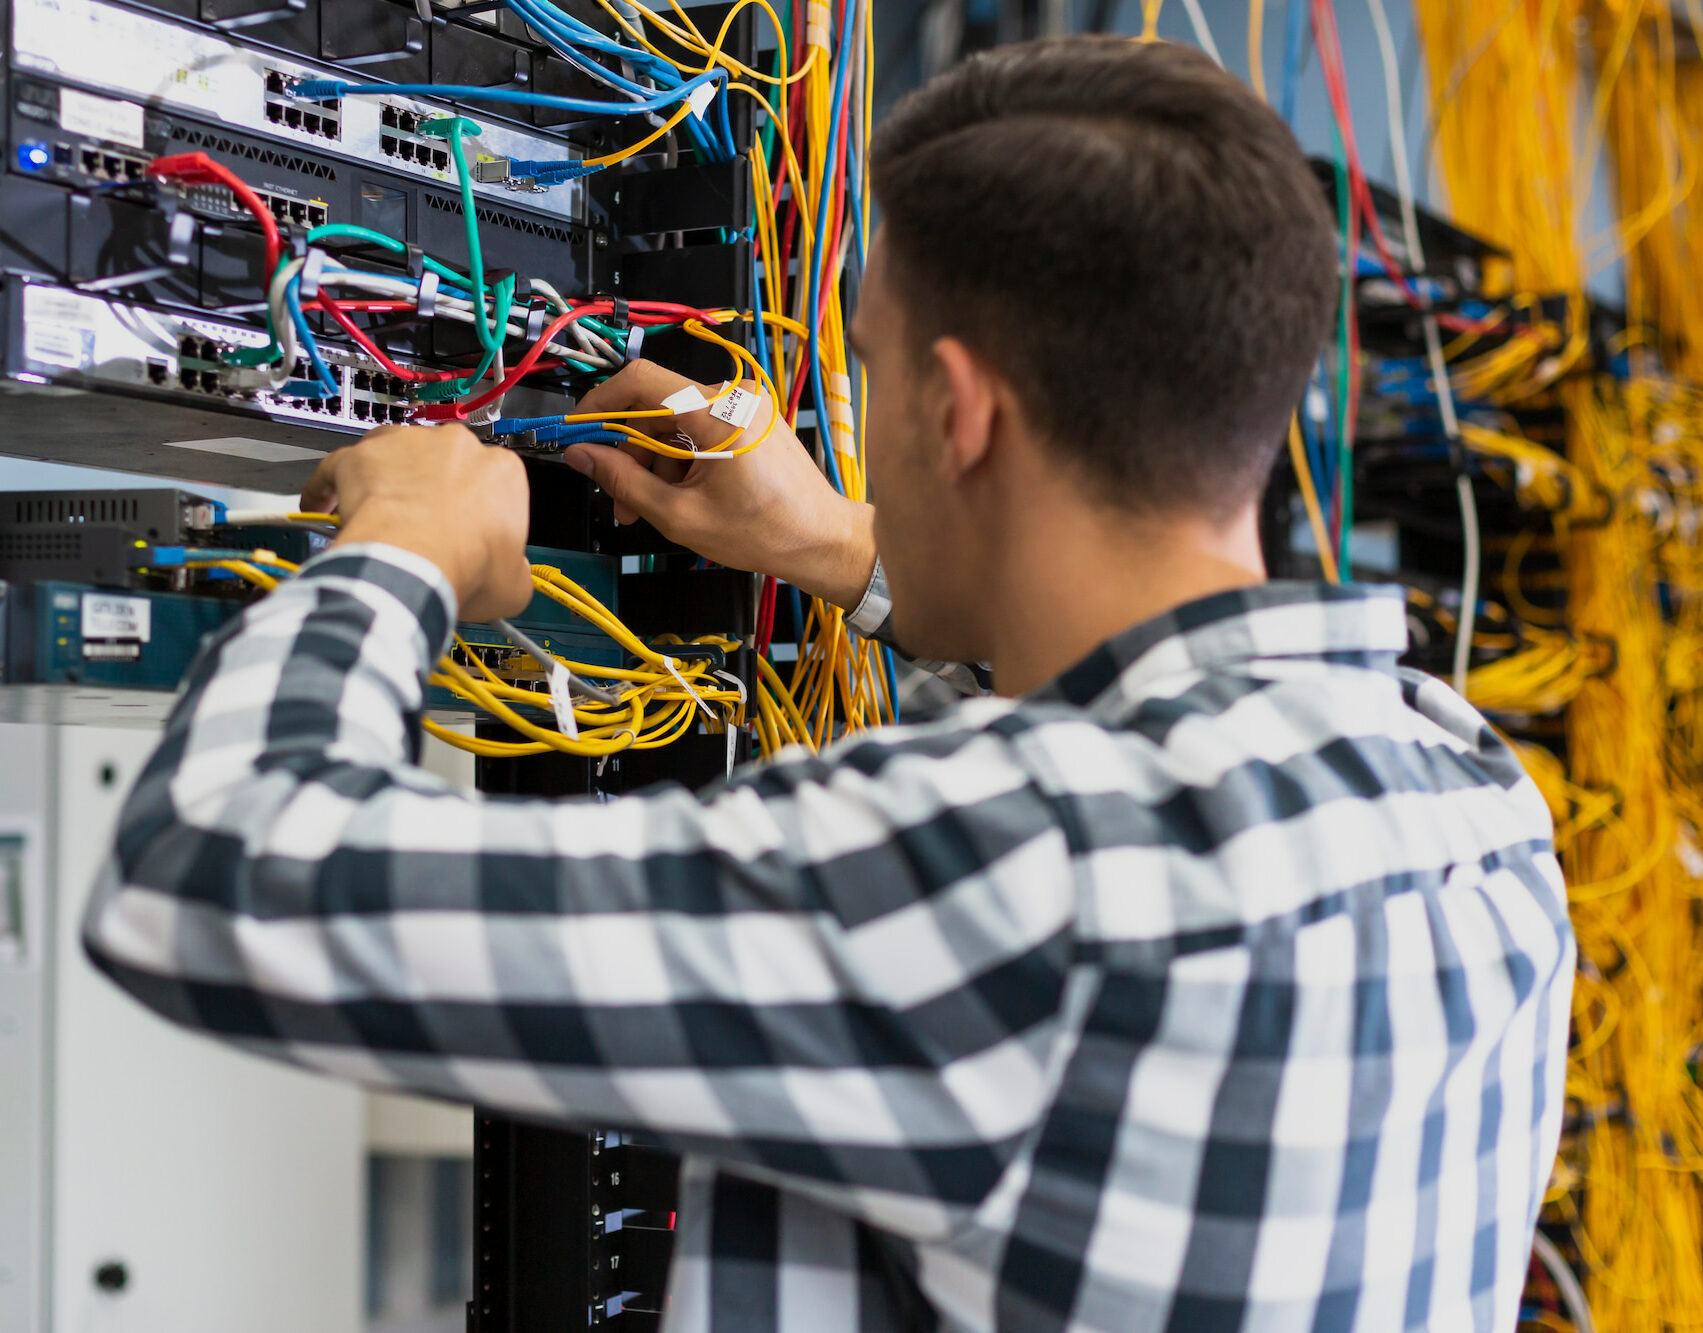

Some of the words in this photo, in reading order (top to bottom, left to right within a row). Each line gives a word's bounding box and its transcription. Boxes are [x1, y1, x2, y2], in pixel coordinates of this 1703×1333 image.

[614, 191, 620, 205] 4
[614, 271, 620, 285] 5
[612, 759, 620, 772] 11
[610, 1172, 620, 1186] 16
[610, 1255, 620, 1270] 17
